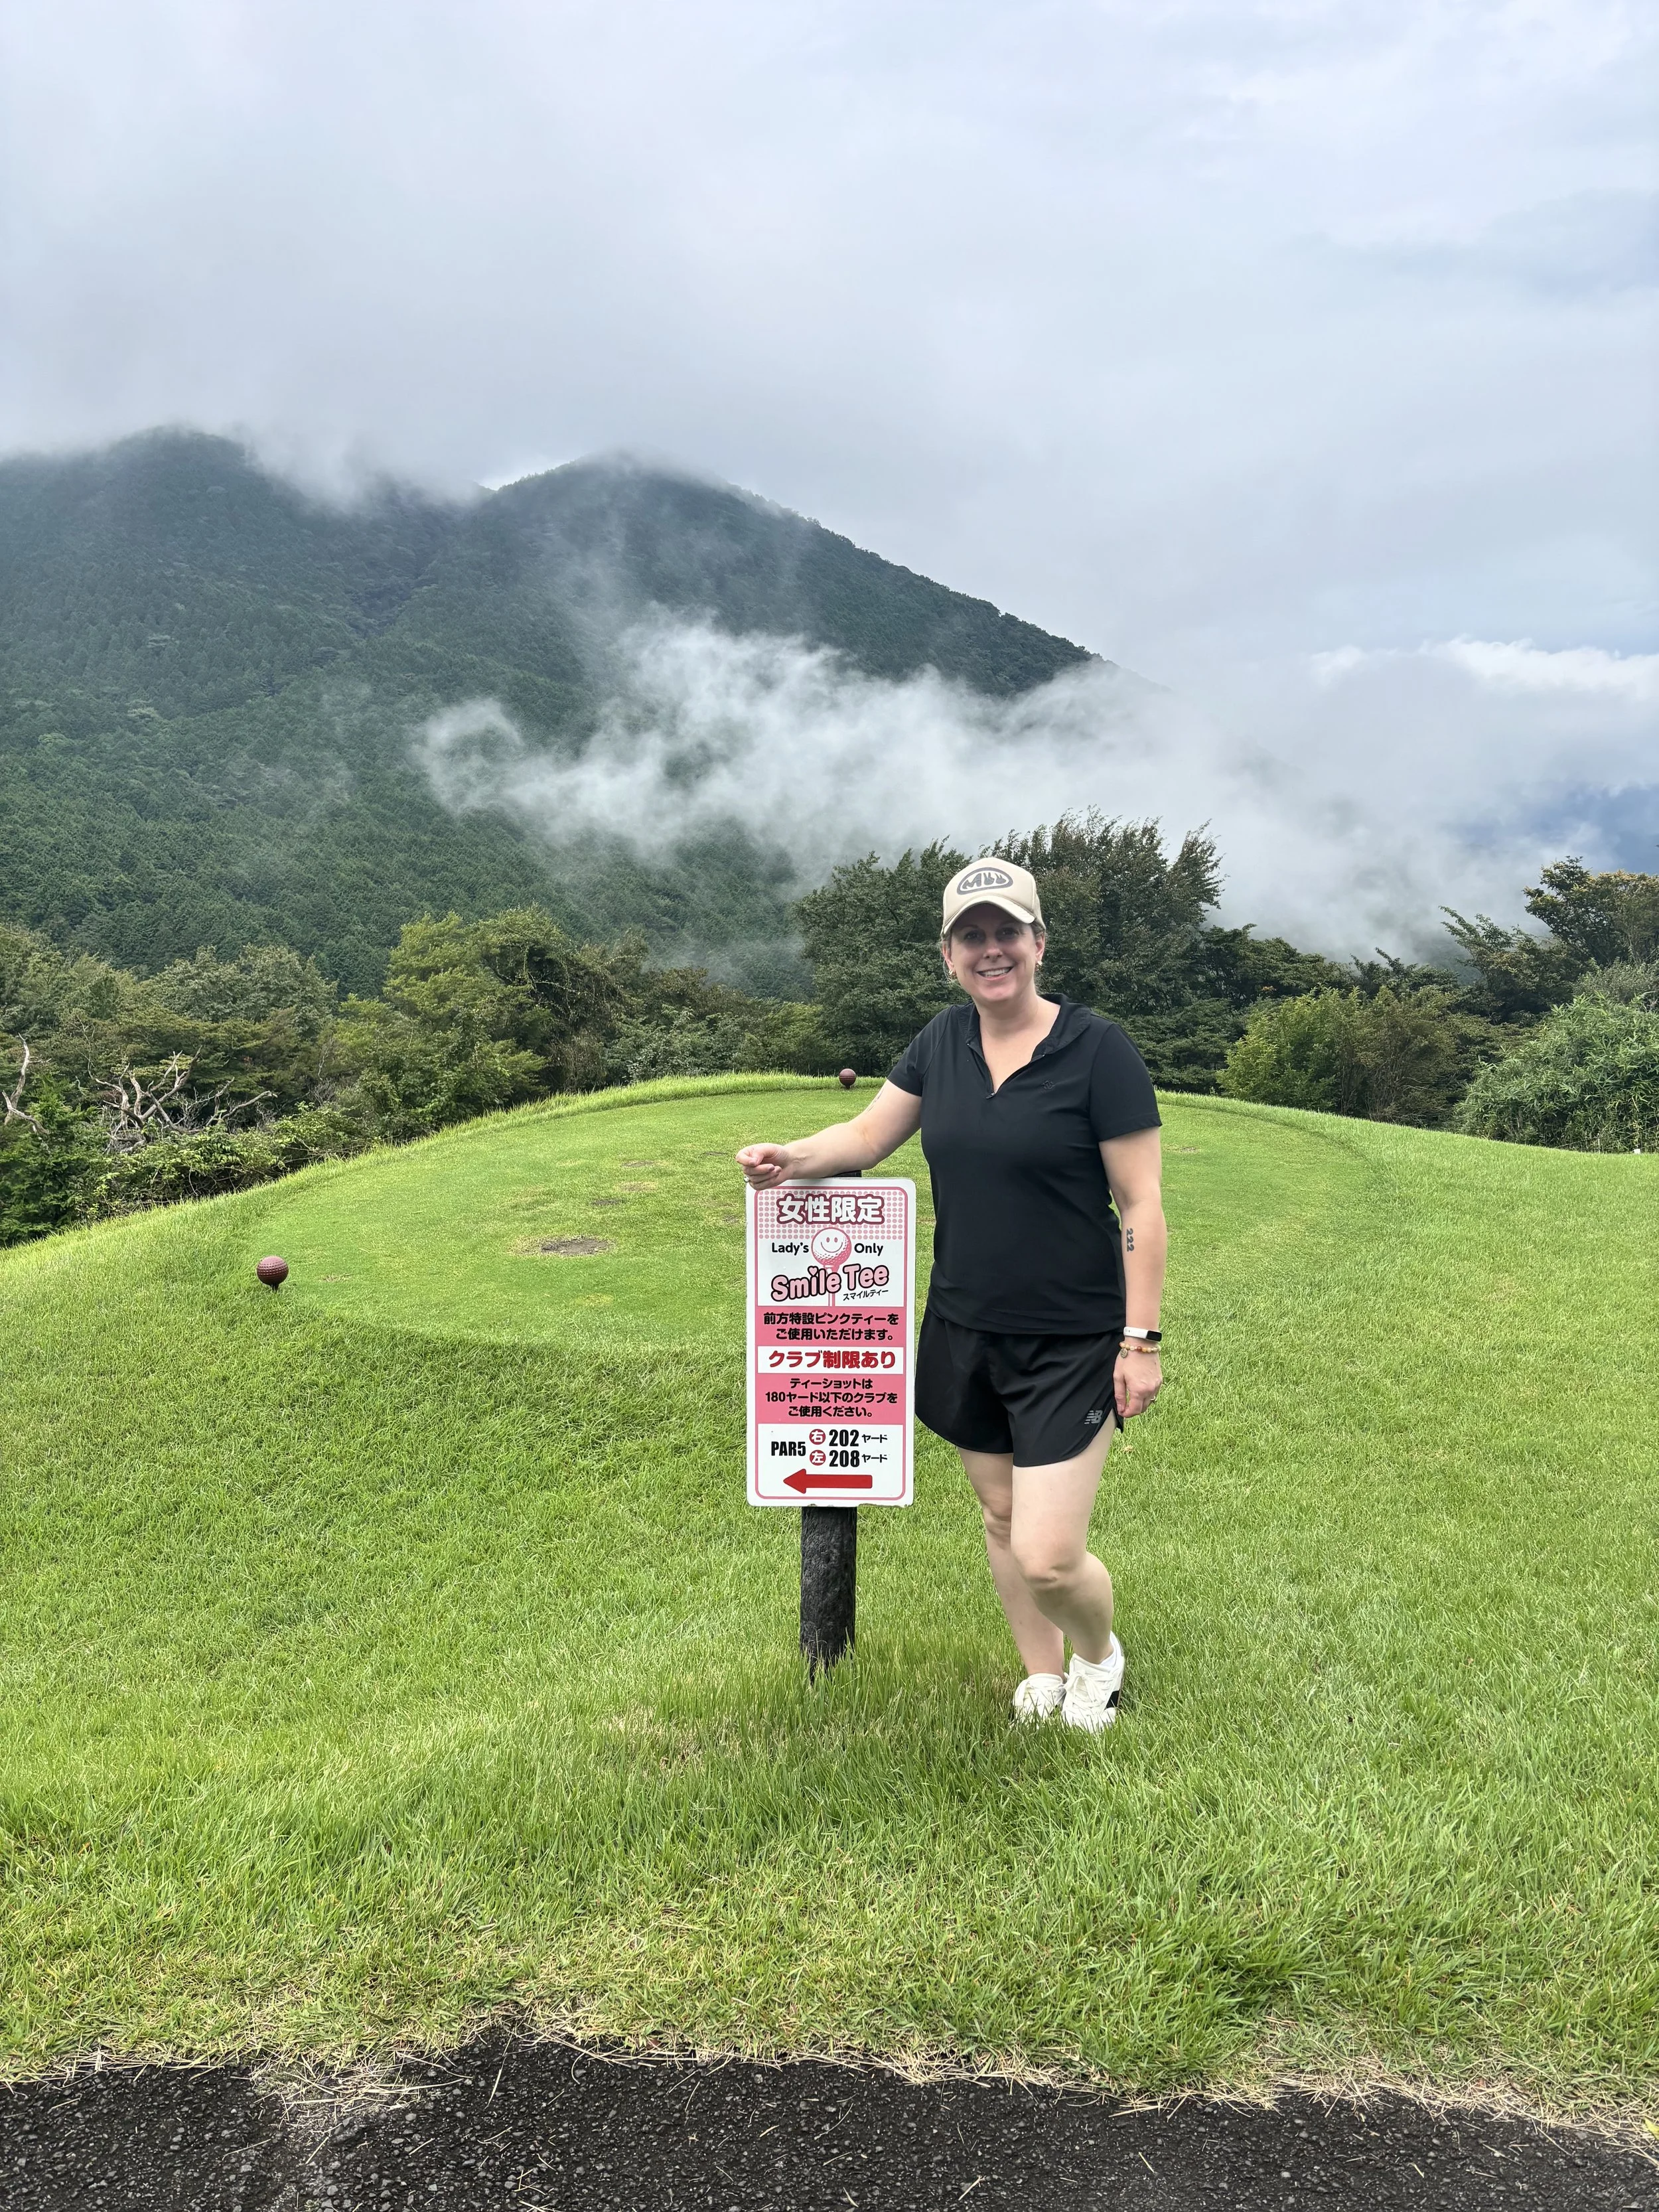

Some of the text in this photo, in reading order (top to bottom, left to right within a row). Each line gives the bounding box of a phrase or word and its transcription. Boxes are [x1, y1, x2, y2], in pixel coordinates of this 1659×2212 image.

[777, 1194, 884, 1224] 女性限定
[1126, 1228, 1135, 1252] 222
[772, 1242, 883, 1256] Lady's Only
[771, 1264, 889, 1301] Smile Tee
[843, 1289, 889, 1301] スマイルティー
[763, 1312, 899, 1325] 前方特設ピンクティーを
[776, 1328, 893, 1341] ご使用いただけます。
[768, 1350, 896, 1368] クラブ制限あり
[790, 1378, 873, 1389] ティーショットは
[765, 1391, 898, 1404] 180ヤード以下のクラブを
[788, 1406, 873, 1417] ご使用ください。
[810, 1430, 888, 1447] 右 202 ヤード
[771, 1441, 806, 1456] PAR5
[810, 1450, 888, 1467] 左 208 ヤード
